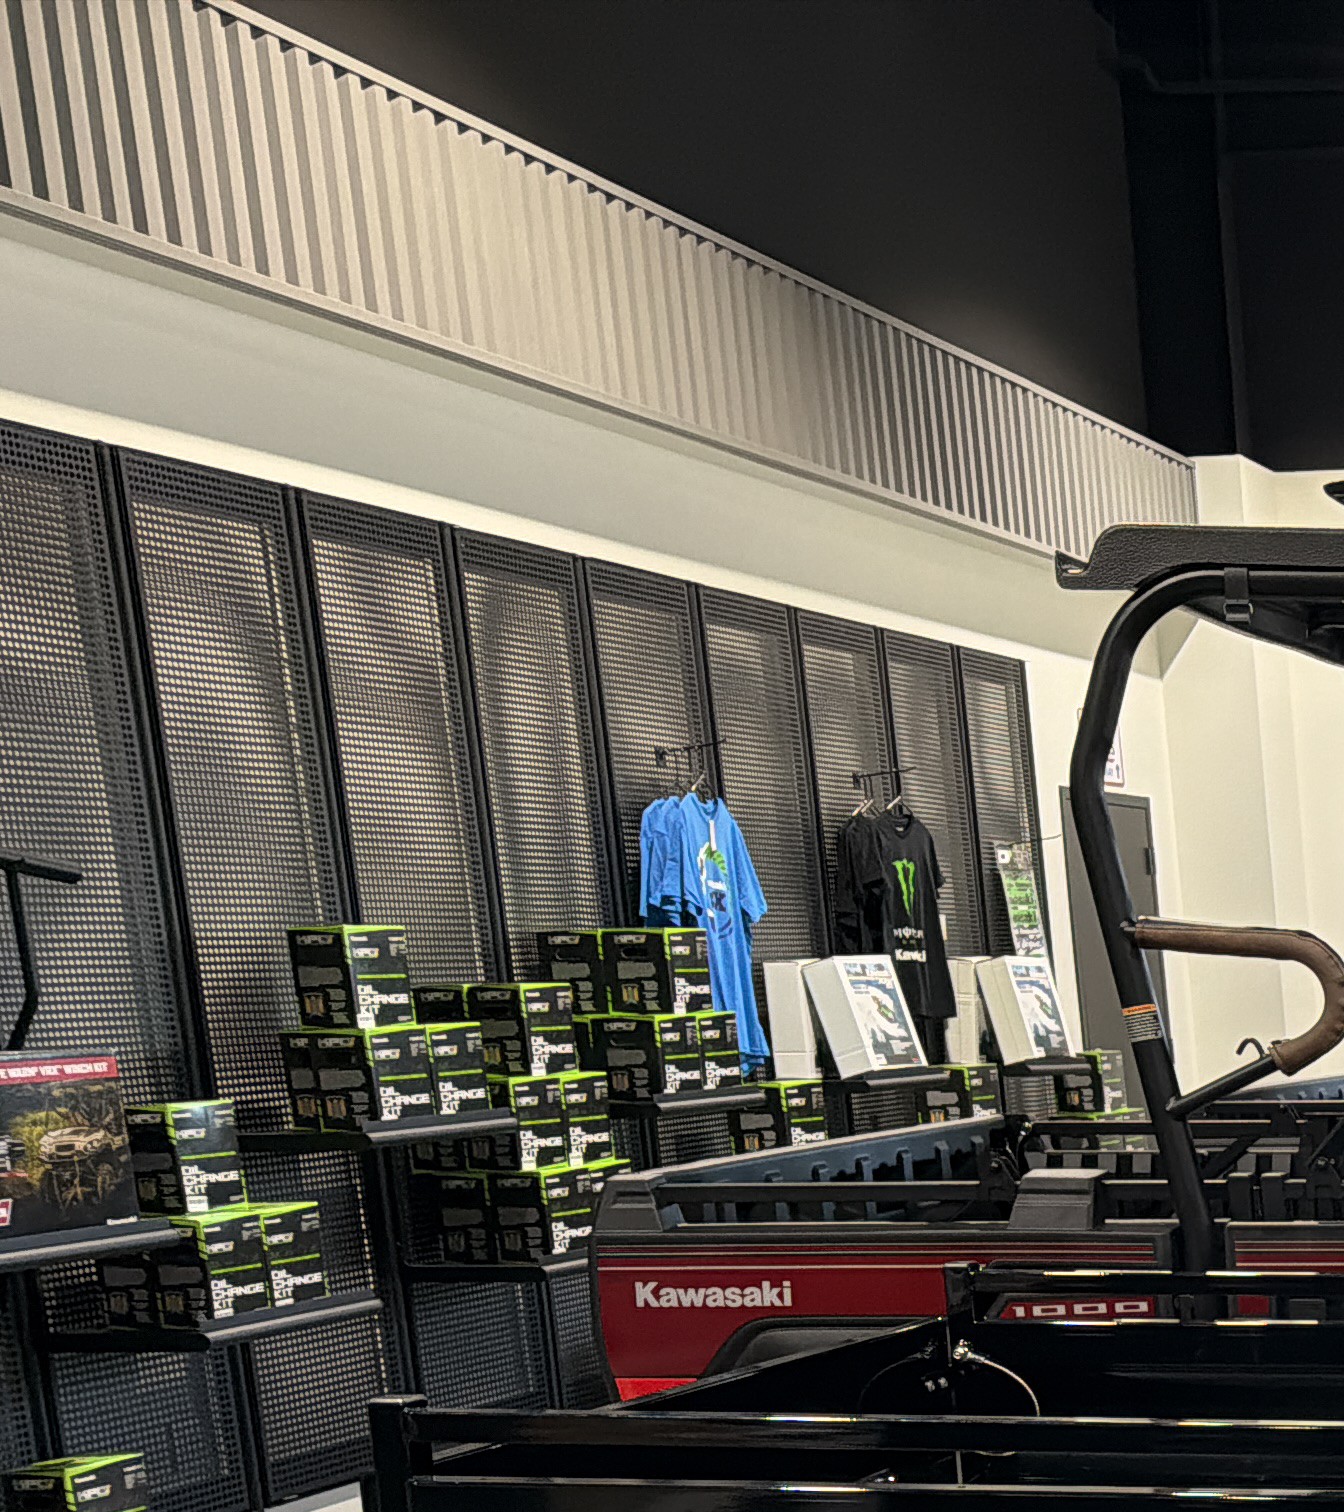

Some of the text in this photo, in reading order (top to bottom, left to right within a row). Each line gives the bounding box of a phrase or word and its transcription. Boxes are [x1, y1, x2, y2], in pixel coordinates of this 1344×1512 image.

[357, 984, 379, 995] OIL
[358, 993, 410, 1004] CHANGE
[379, 1085, 400, 1097] OIL
[438, 1081, 459, 1092] OIL
[440, 1087, 487, 1100] CHANGE
[381, 1093, 431, 1107] CHANGE
[181, 1165, 206, 1176] OIL
[183, 1170, 240, 1186] CHANGE
[184, 1184, 208, 1196] KIT
[271, 1268, 293, 1280] OIL
[211, 1278, 233, 1290] OIL
[272, 1272, 323, 1290] CHANGE
[212, 1282, 265, 1300] CHANGE
[273, 1287, 295, 1299] KIT
[634, 1280, 793, 1308] Kawasaki
[213, 1298, 236, 1310] KIT
[1012, 1301, 1149, 1318] 1000
